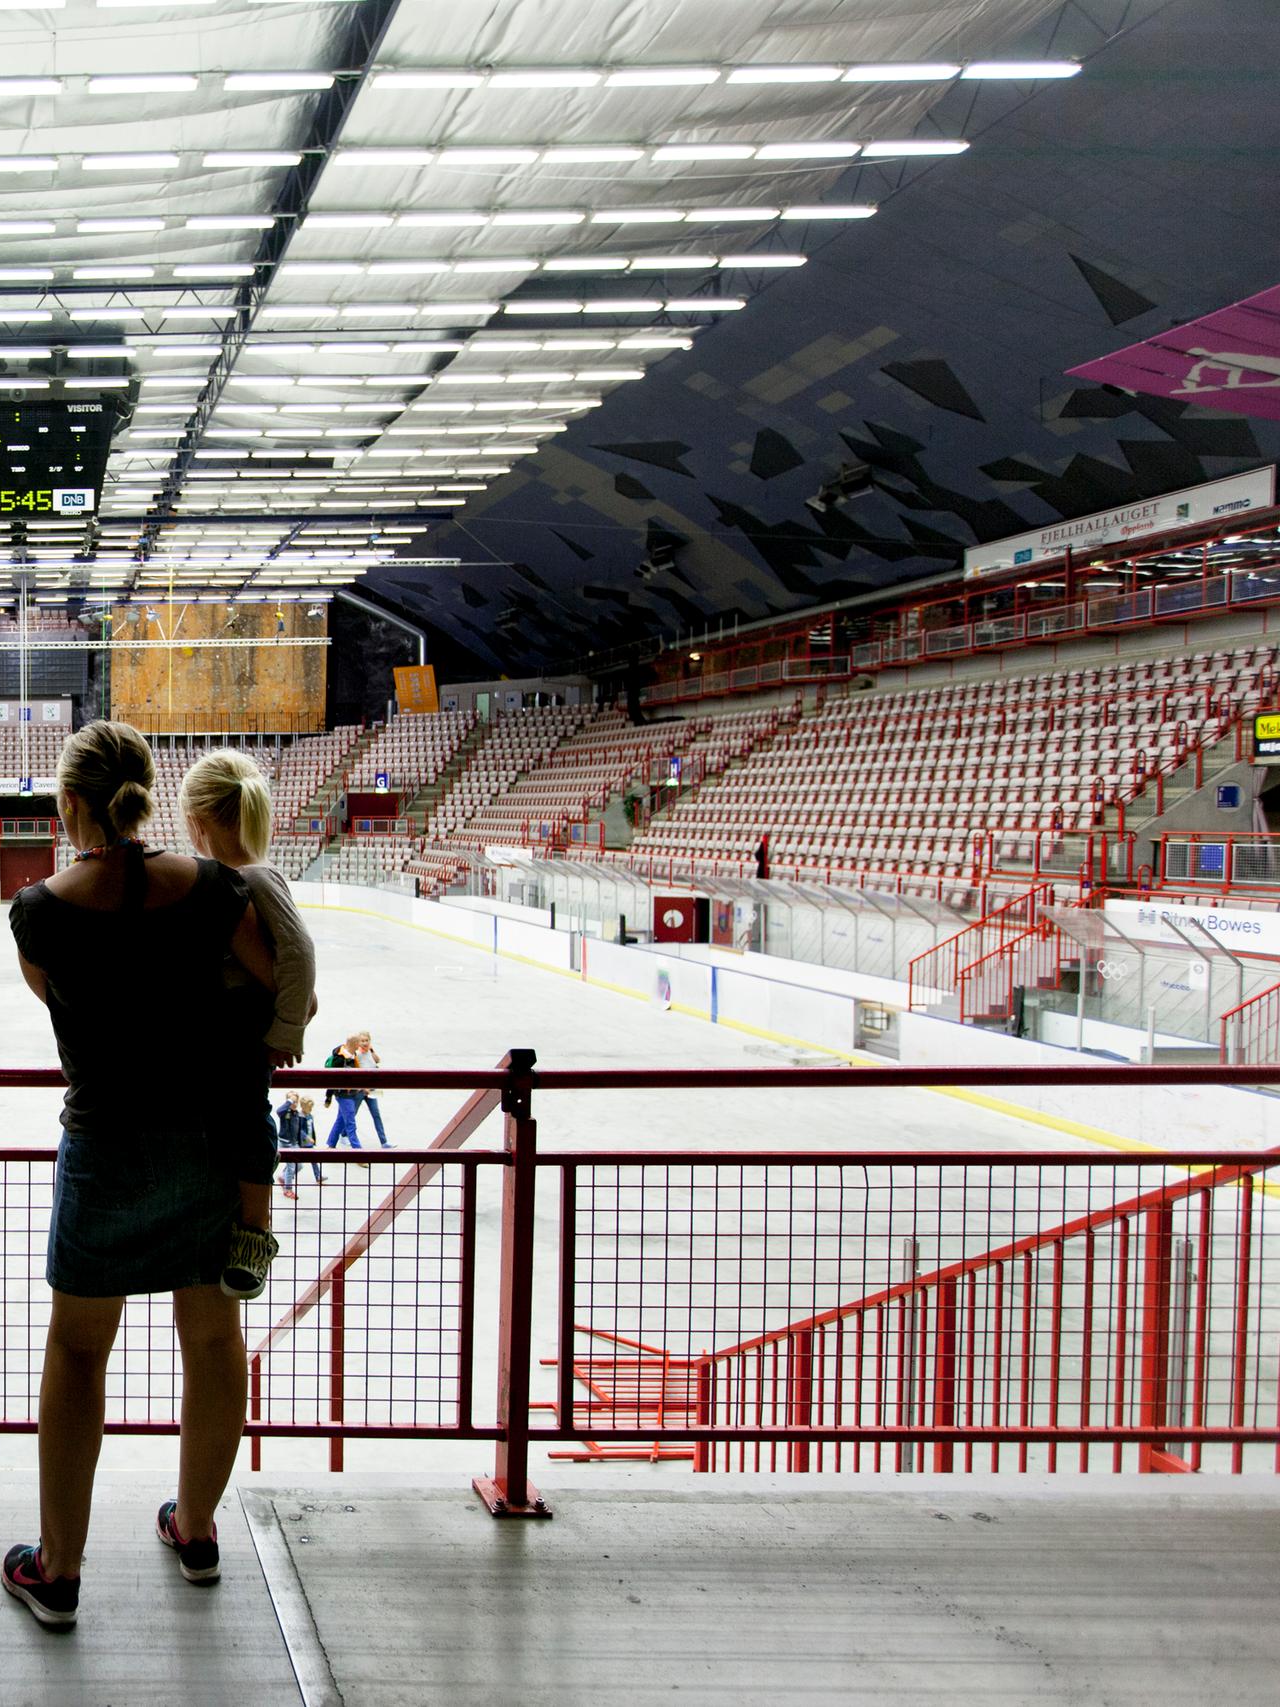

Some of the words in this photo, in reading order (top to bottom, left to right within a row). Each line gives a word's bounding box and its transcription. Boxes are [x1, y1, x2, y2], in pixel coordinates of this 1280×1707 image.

[67, 404, 103, 413] VISITOR
[63, 494, 85, 506] DNB
[1041, 502, 1161, 546] FJELLHALLAUGET
[670, 763, 678, 777] H
[376, 777, 385, 787] G
[1208, 915, 1262, 935] Bowes
